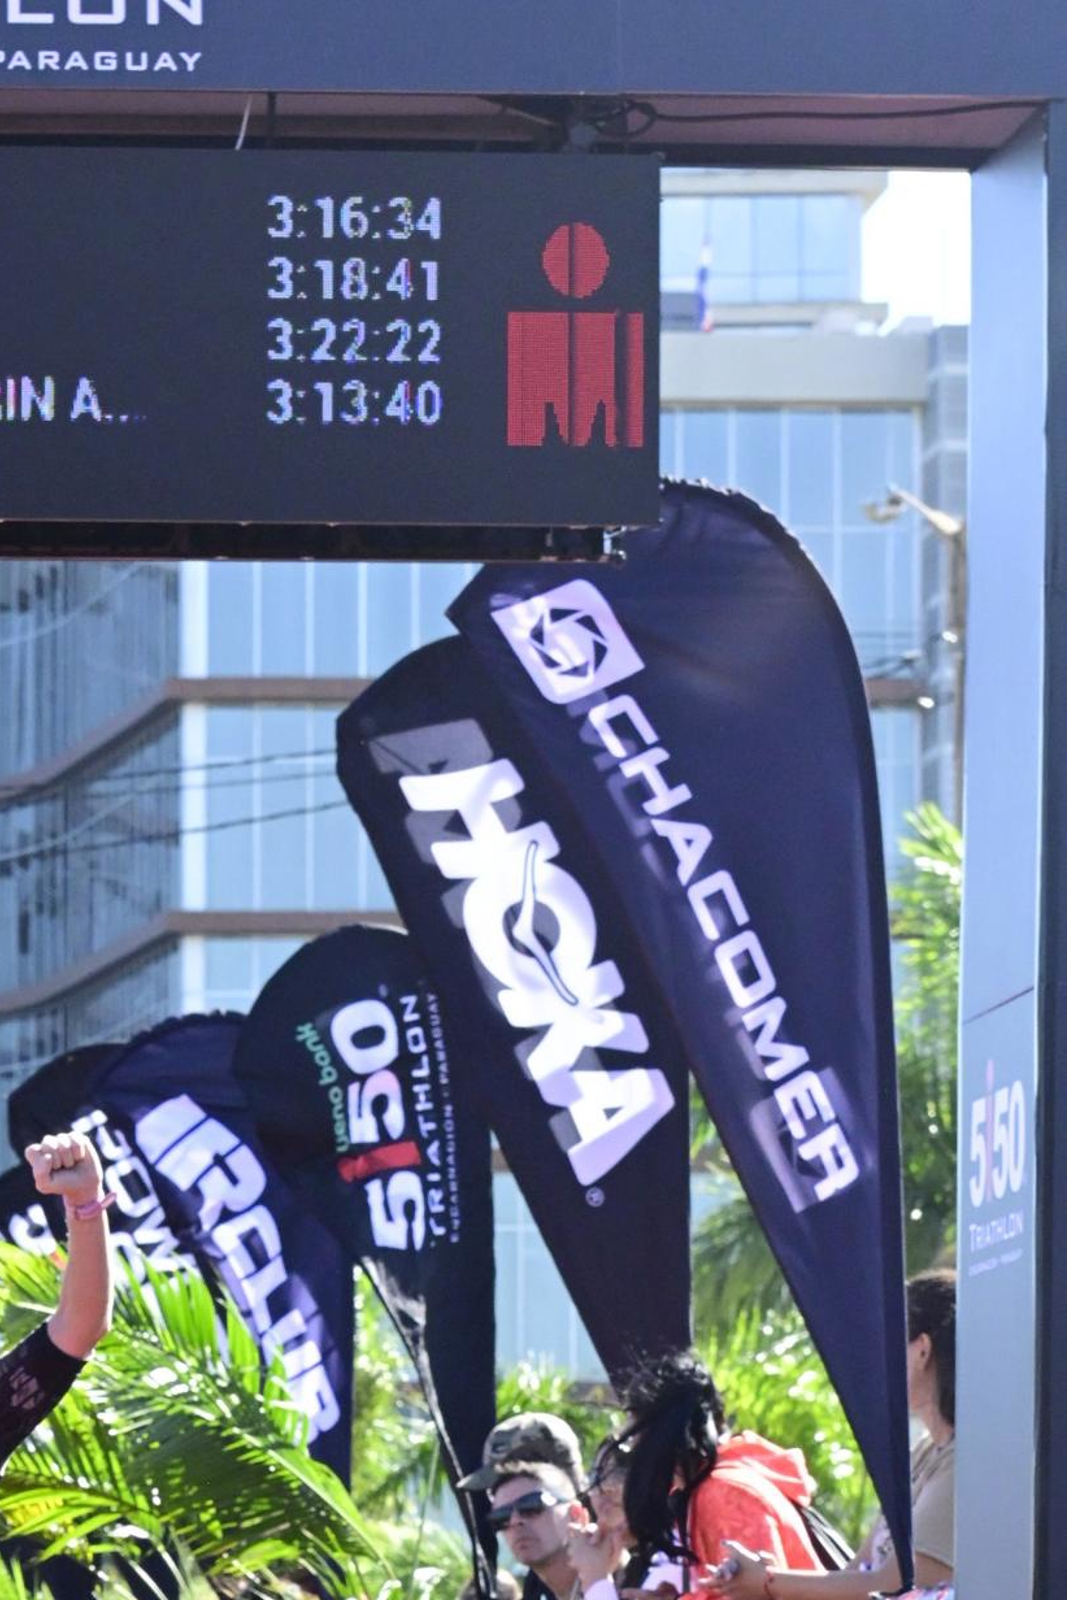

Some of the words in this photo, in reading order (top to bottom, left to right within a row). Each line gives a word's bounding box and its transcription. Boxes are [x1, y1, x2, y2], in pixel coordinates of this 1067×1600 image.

[267, 195, 441, 240] 3:16:34
[267, 256, 439, 301] 3:18:41
[267, 317, 441, 363] 3:22:22
[266, 379, 442, 425] 3:13:40
[399, 758, 676, 1187] HOKA
[588, 694, 860, 1202] CHACOMER
[295, 1022, 339, 1087] bank
[328, 1086, 350, 1153] ueno
[400, 994, 446, 1247] TRIATHLON
